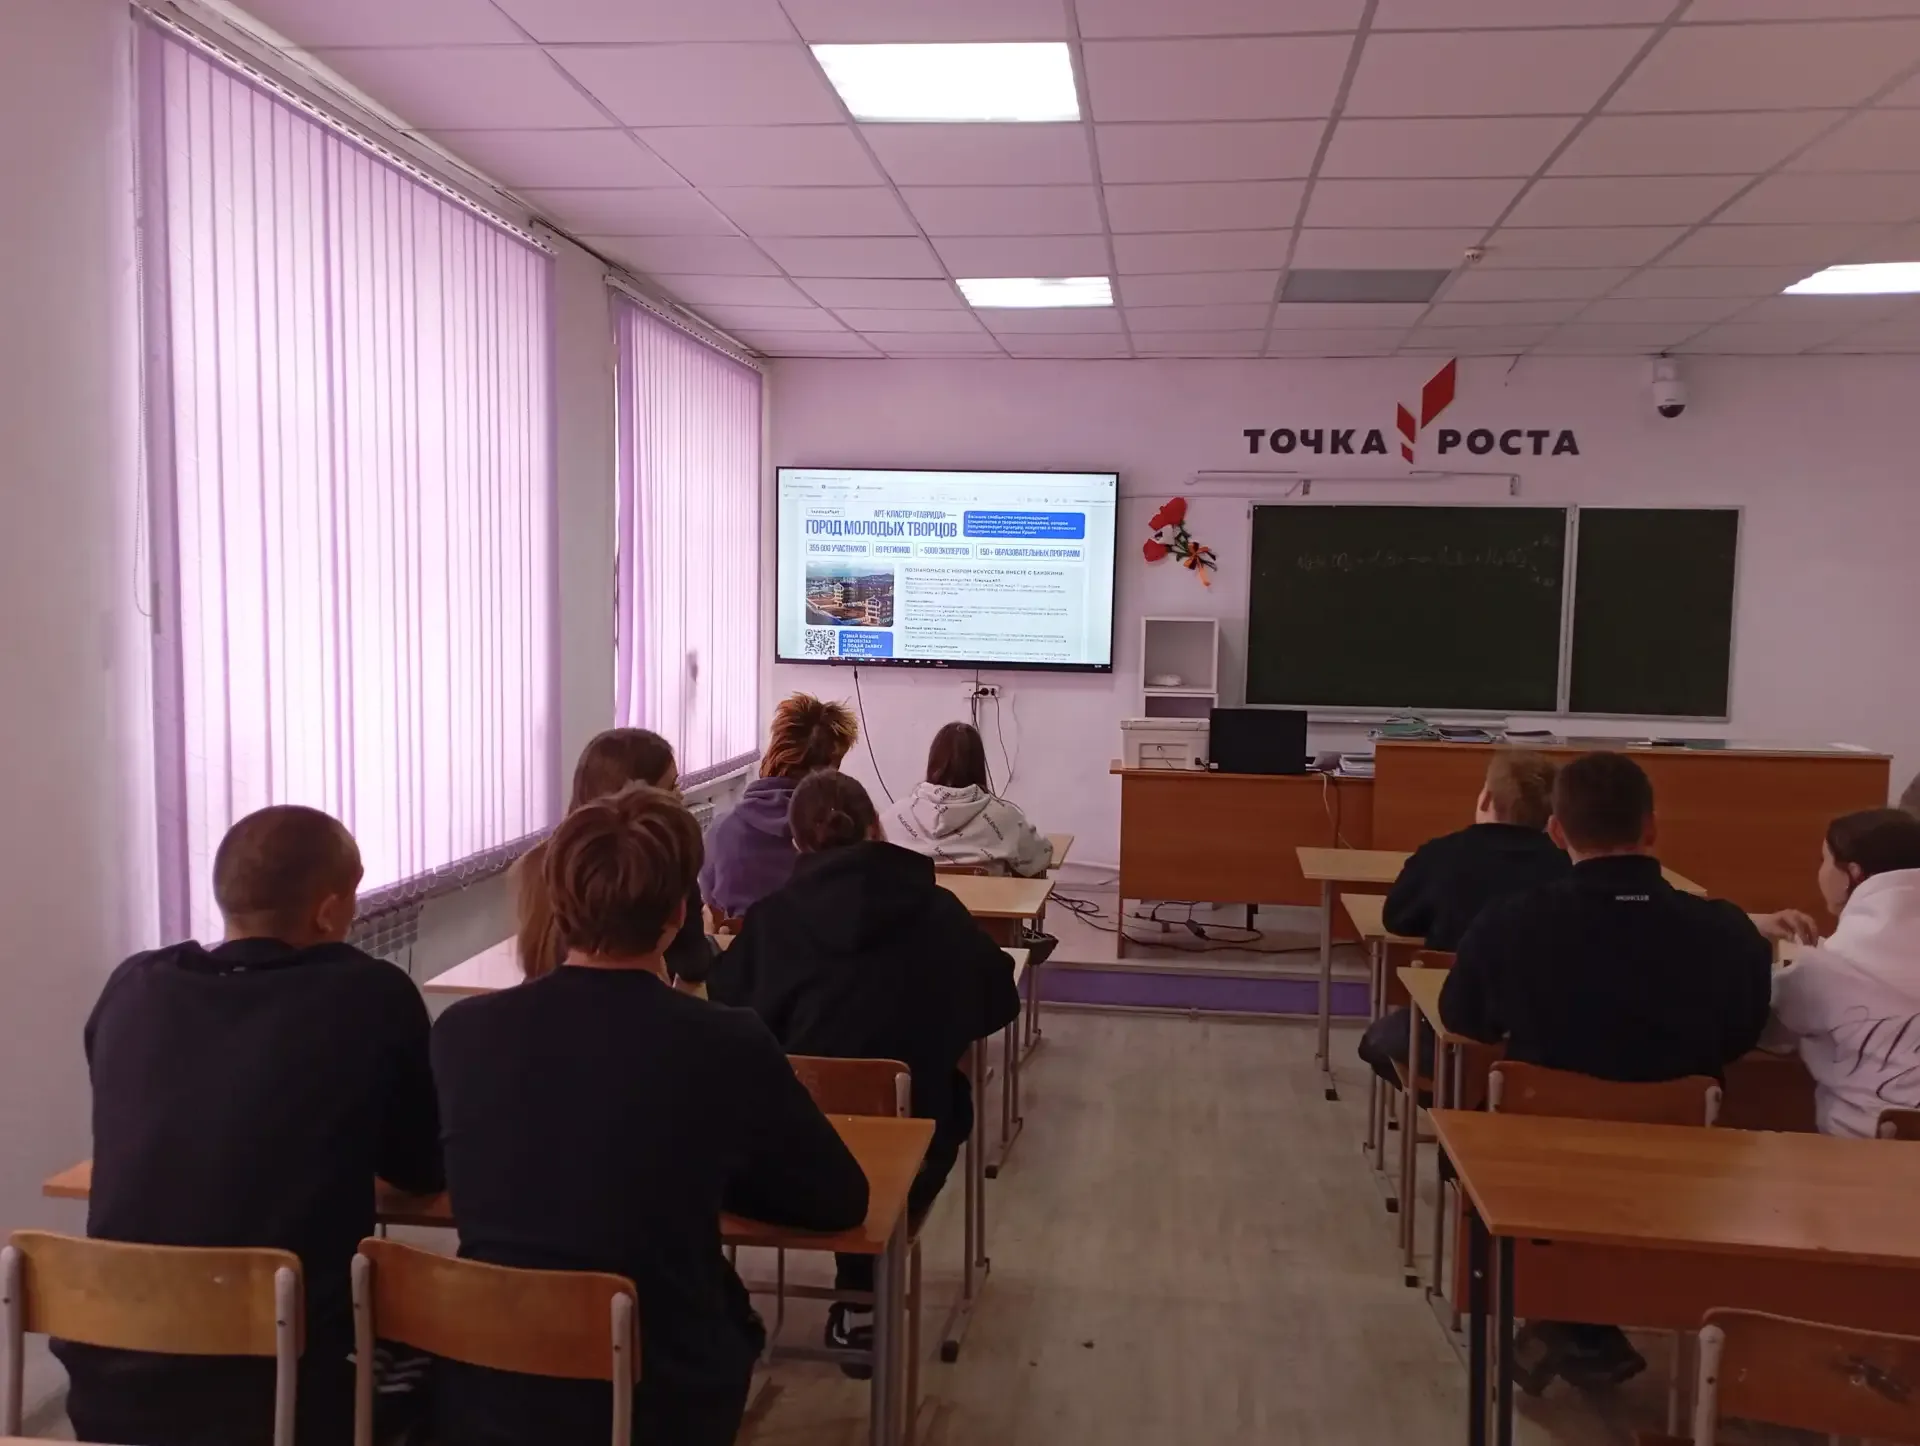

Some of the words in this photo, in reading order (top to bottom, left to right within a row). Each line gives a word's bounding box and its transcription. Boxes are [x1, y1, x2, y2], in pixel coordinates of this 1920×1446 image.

[1243, 428, 1388, 455] ТОЧКА
[1437, 429, 1580, 456] РОСТА
[873, 509, 912, 519] АРТ-КЛАСТЕР
[806, 519, 842, 536] ГОРОД
[844, 520, 905, 537] МОЛОДЫХ
[907, 521, 957, 538] ТВОРЦОВ
[832, 544, 867, 553] УЧАСТНИКОВ
[884, 546, 911, 554] РЕГИОНОВ
[939, 547, 970, 556] ЭКСПЕРТОВ
[995, 548, 1049, 557] ОБРАЗОВАТЕЛЬНЫХ
[1050, 549, 1080, 557] ПРОГРАММ
